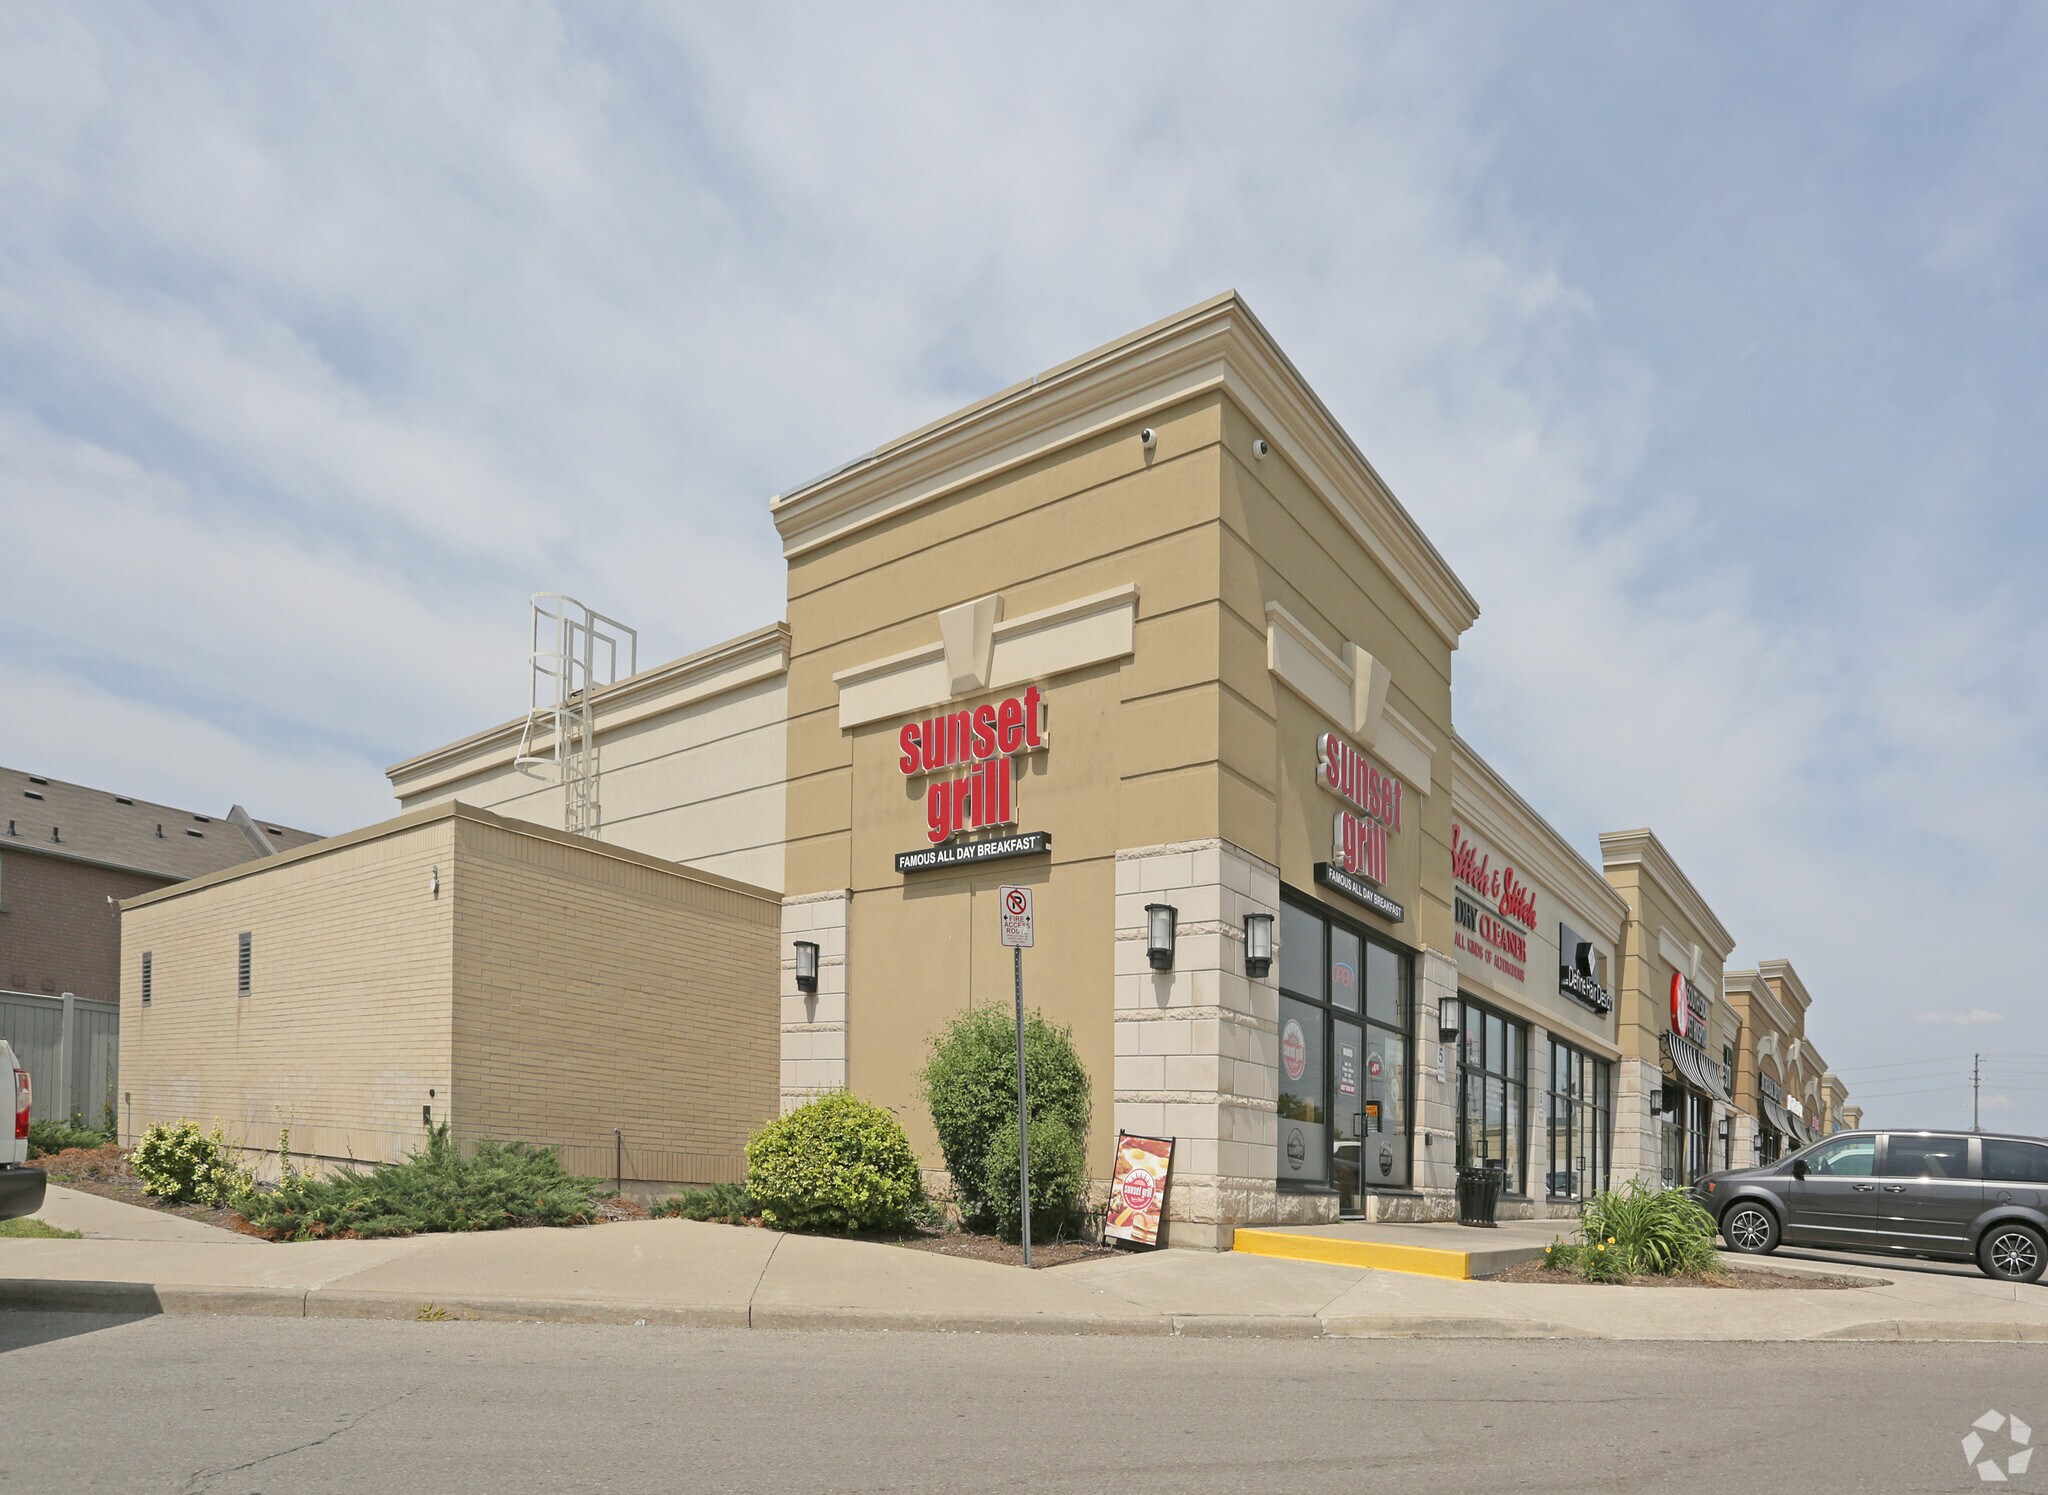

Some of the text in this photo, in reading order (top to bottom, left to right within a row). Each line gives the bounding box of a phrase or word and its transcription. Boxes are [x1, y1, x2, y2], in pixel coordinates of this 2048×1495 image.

[899, 685, 1041, 775] sunset
[927, 757, 1010, 843] grill
[1324, 732, 1403, 835] sunset
[900, 836, 1036, 868] FAMOUS ALL DAY BREAKFAST
[1342, 810, 1388, 887] grill
[1451, 823, 1537, 930] Stitch & Stitch
[1009, 915, 1025, 923] FIRE
[1328, 868, 1402, 917] FAMOUS ALL DAY BREAKFAST
[1454, 931, 1465, 950] ALL
[1467, 938, 1484, 960] KINDS
[1485, 948, 1493, 964] OF
[1455, 896, 1527, 963] DRY CLEANER
[1332, 965, 1353, 989] OPEN
[1124, 1185, 1152, 1199] sunset grill
